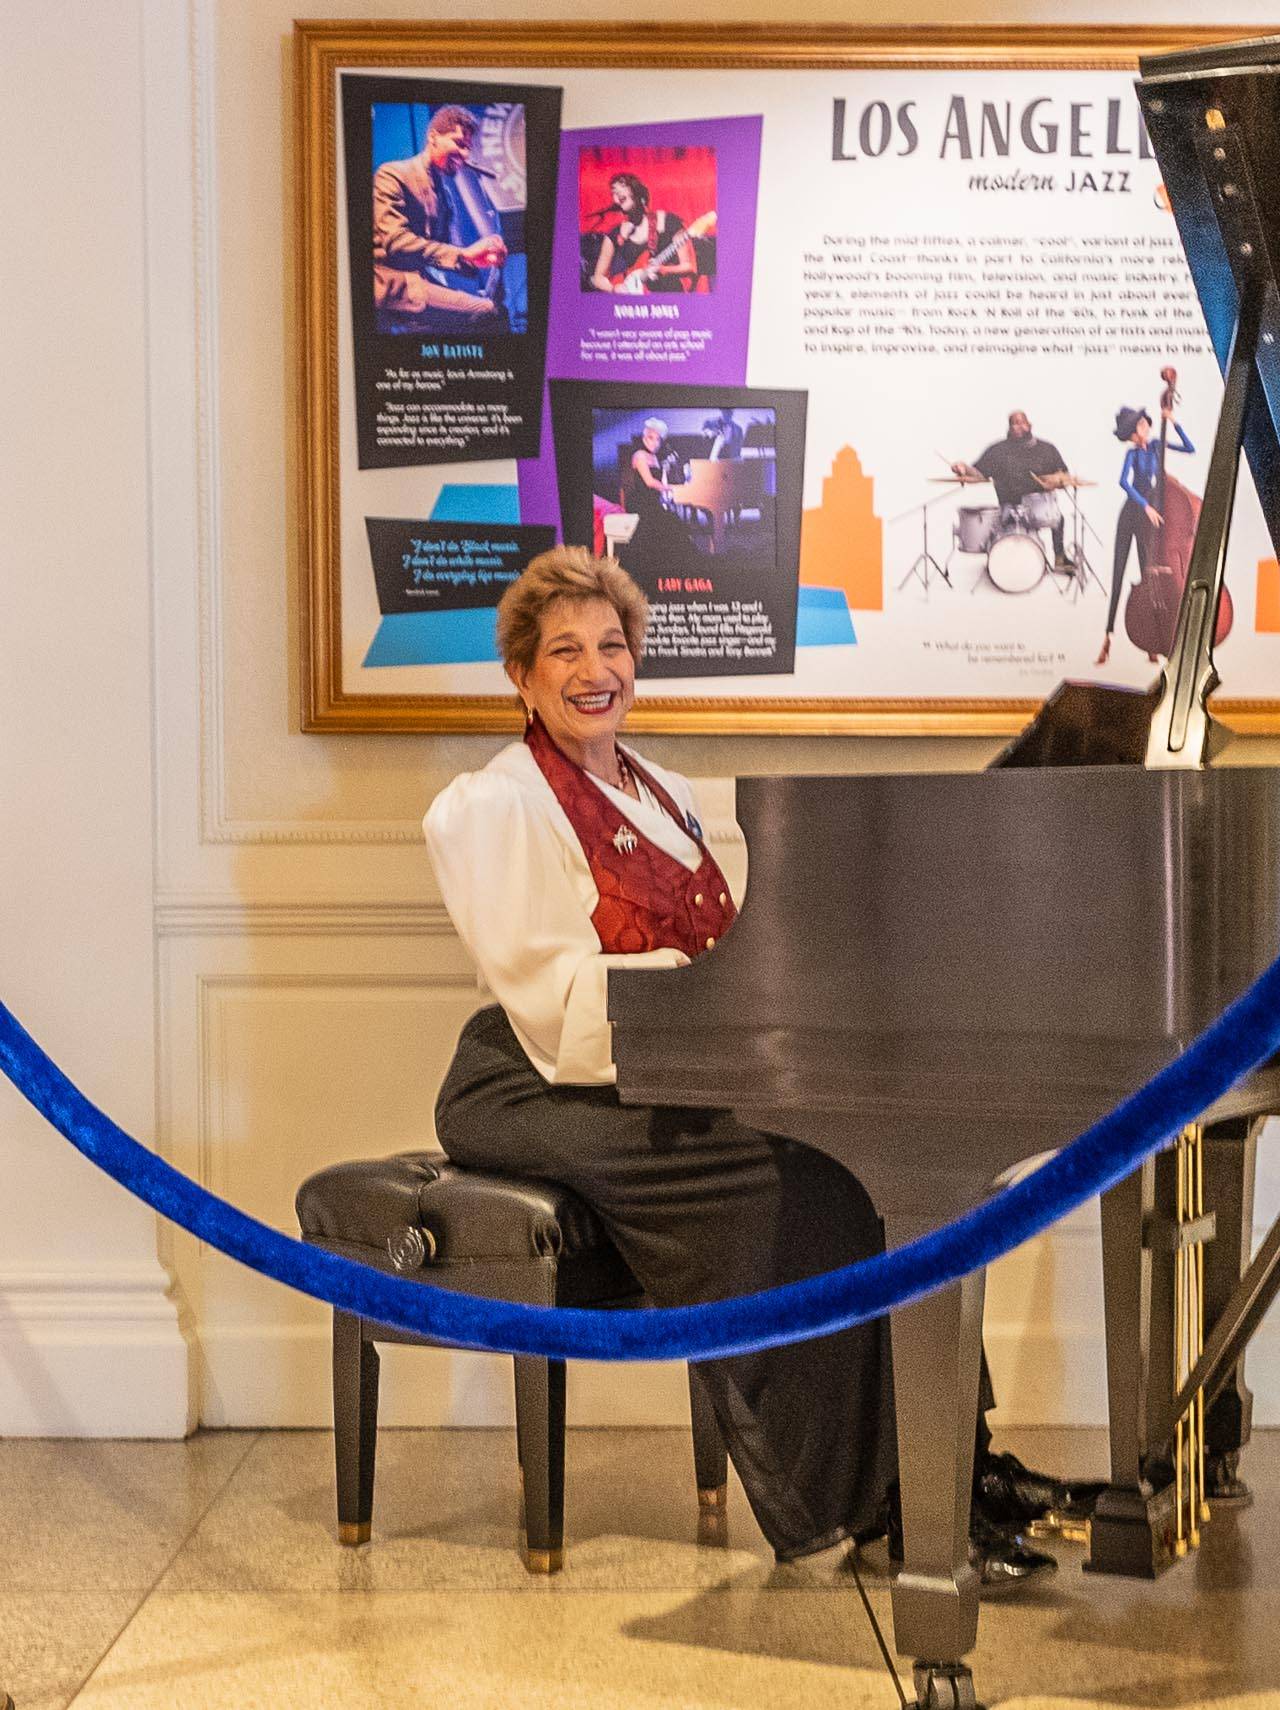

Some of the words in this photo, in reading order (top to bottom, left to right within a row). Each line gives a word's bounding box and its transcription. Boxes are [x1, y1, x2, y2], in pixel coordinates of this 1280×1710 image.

[831, 96, 919, 161] LOS
[967, 168, 1055, 192] modern
[1065, 171, 1132, 193] JAZZ
[822, 235, 866, 248] During
[870, 235, 890, 246] the
[1081, 235, 1129, 246] variant
[1132, 234, 1146, 246] of
[1148, 235, 1174, 249] jazz
[803, 253, 824, 264] the
[832, 253, 862, 264] West
[966, 254, 977, 264] in
[984, 254, 1012, 266] part
[1019, 254, 1033, 265] to
[1119, 256, 1153, 265] more
[885, 271, 943, 285] booming
[1052, 271, 1077, 283] and
[1082, 271, 1119, 283] music
[850, 289, 908, 300] elements
[915, 289, 928, 300] of
[933, 289, 959, 303] jazz
[965, 289, 1000, 300] could
[1006, 289, 1023, 300] be
[1029, 289, 1068, 300] heard
[1073, 289, 1085, 300] in
[1089, 289, 1112, 303] just
[1118, 289, 1156, 300] about
[613, 304, 649, 319] NORAH
[649, 304, 680, 319] JONES
[803, 307, 851, 320] popular
[911, 307, 943, 317] from
[948, 307, 977, 317] Rock
[1000, 307, 1022, 317] Roll
[1026, 307, 1039, 317] of
[1045, 307, 1065, 317] the
[1103, 307, 1116, 317] to
[1120, 307, 1149, 317] Funk
[1154, 307, 1167, 317] of
[1173, 307, 1193, 317] the
[804, 325, 828, 335] and
[858, 325, 870, 335] of
[874, 325, 895, 335] the
[972, 327, 981, 336] a
[984, 327, 1010, 336] new
[1014, 325, 1085, 338] generation
[1088, 325, 1102, 336] of
[1105, 325, 1146, 336] artists
[1148, 325, 1173, 336] and
[804, 343, 817, 353] to
[944, 343, 968, 353] and
[971, 343, 1038, 356] reimagine
[1041, 343, 1073, 353] what
[1119, 344, 1162, 354] means
[1165, 343, 1179, 354] to
[1182, 343, 1203, 354] the
[657, 577, 682, 592] LADY
[683, 577, 713, 592] GAGA
